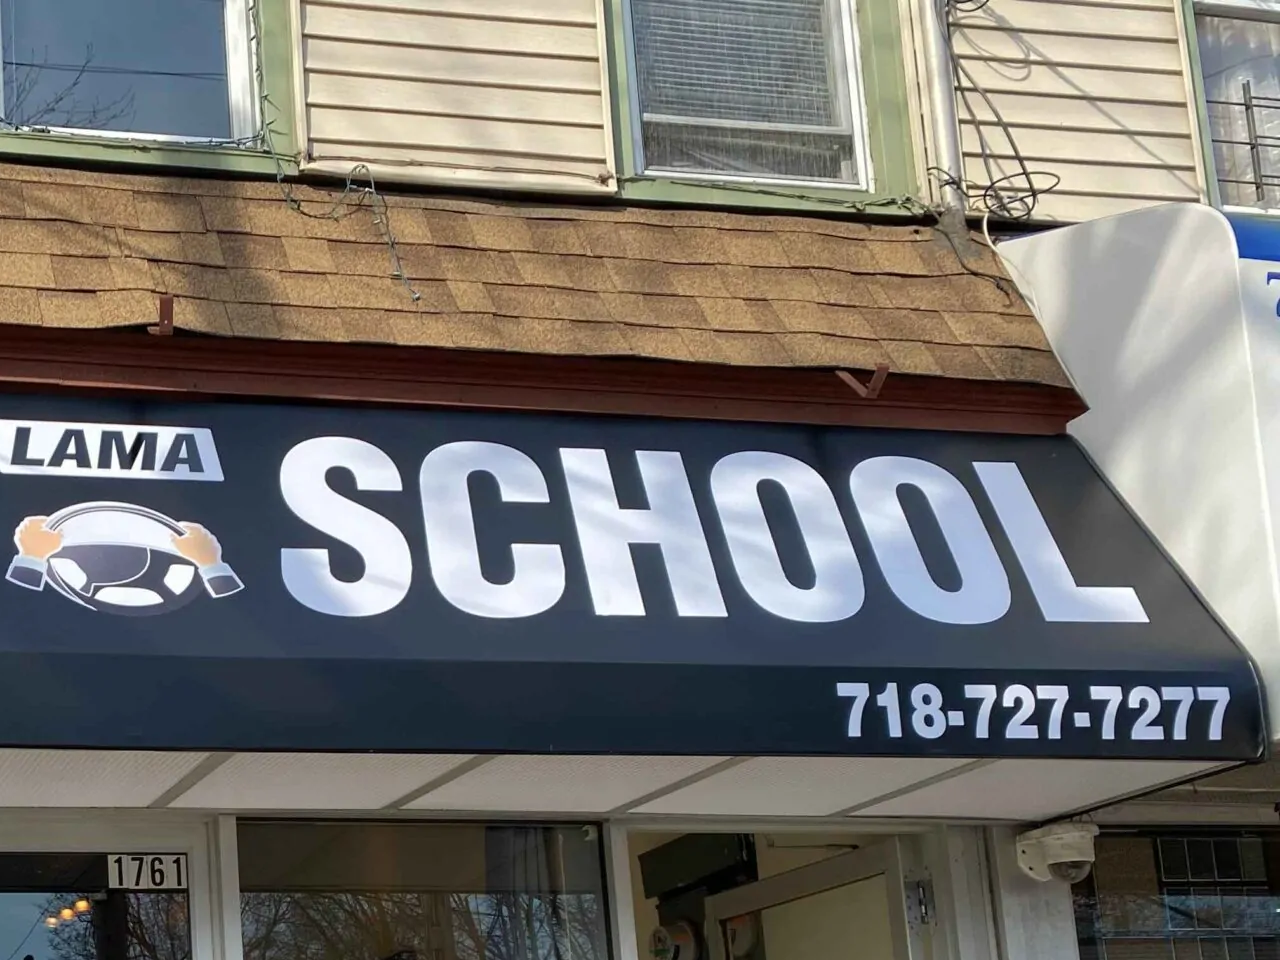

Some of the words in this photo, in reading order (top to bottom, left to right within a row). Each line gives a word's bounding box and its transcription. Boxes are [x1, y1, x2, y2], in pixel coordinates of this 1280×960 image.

[9, 427, 205, 473] LAMA
[280, 436, 1150, 625] SCHOOL
[836, 682, 1232, 741] 718-727-7277
[113, 856, 182, 887] 1761
